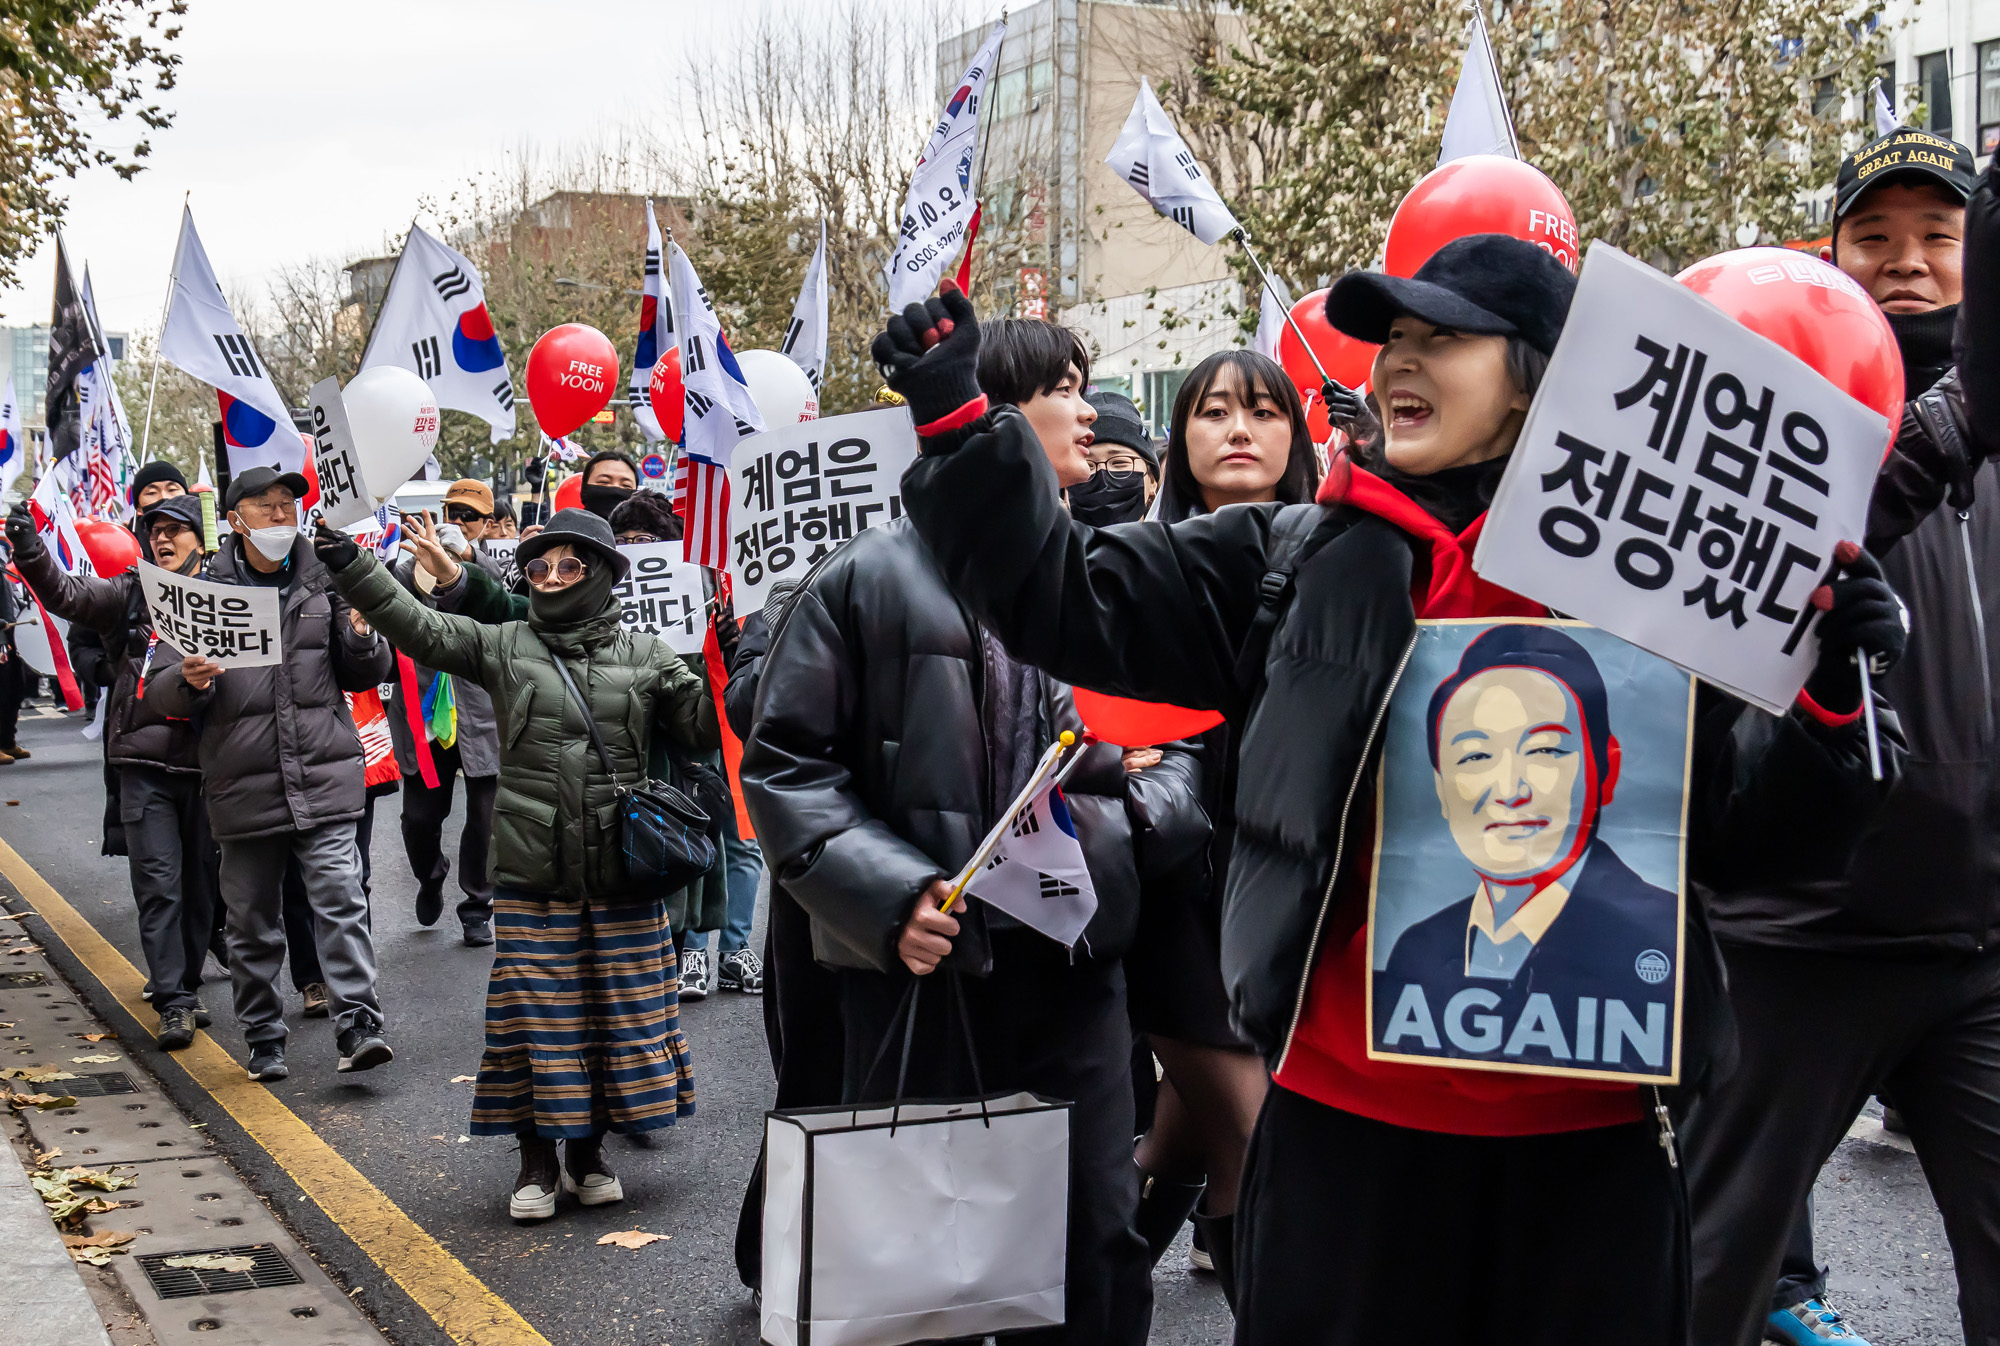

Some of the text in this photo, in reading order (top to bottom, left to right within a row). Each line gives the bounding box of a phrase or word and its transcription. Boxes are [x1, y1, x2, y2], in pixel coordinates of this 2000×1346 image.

[1853, 133, 1959, 166] MAKE AMERICA
[1858, 149, 1955, 180] GREAT AGAIN
[1528, 208, 1577, 252] FREE
[560, 372, 604, 394] YOON
[569, 359, 604, 378] FREE
[1613, 334, 1830, 530] 계엄은
[741, 437, 878, 512] 계엄은
[1538, 430, 1821, 656] 정당했다
[157, 581, 253, 628] 계엄은
[151, 604, 273, 660] 정당했다
[1382, 983, 1666, 1067] AGAIN
